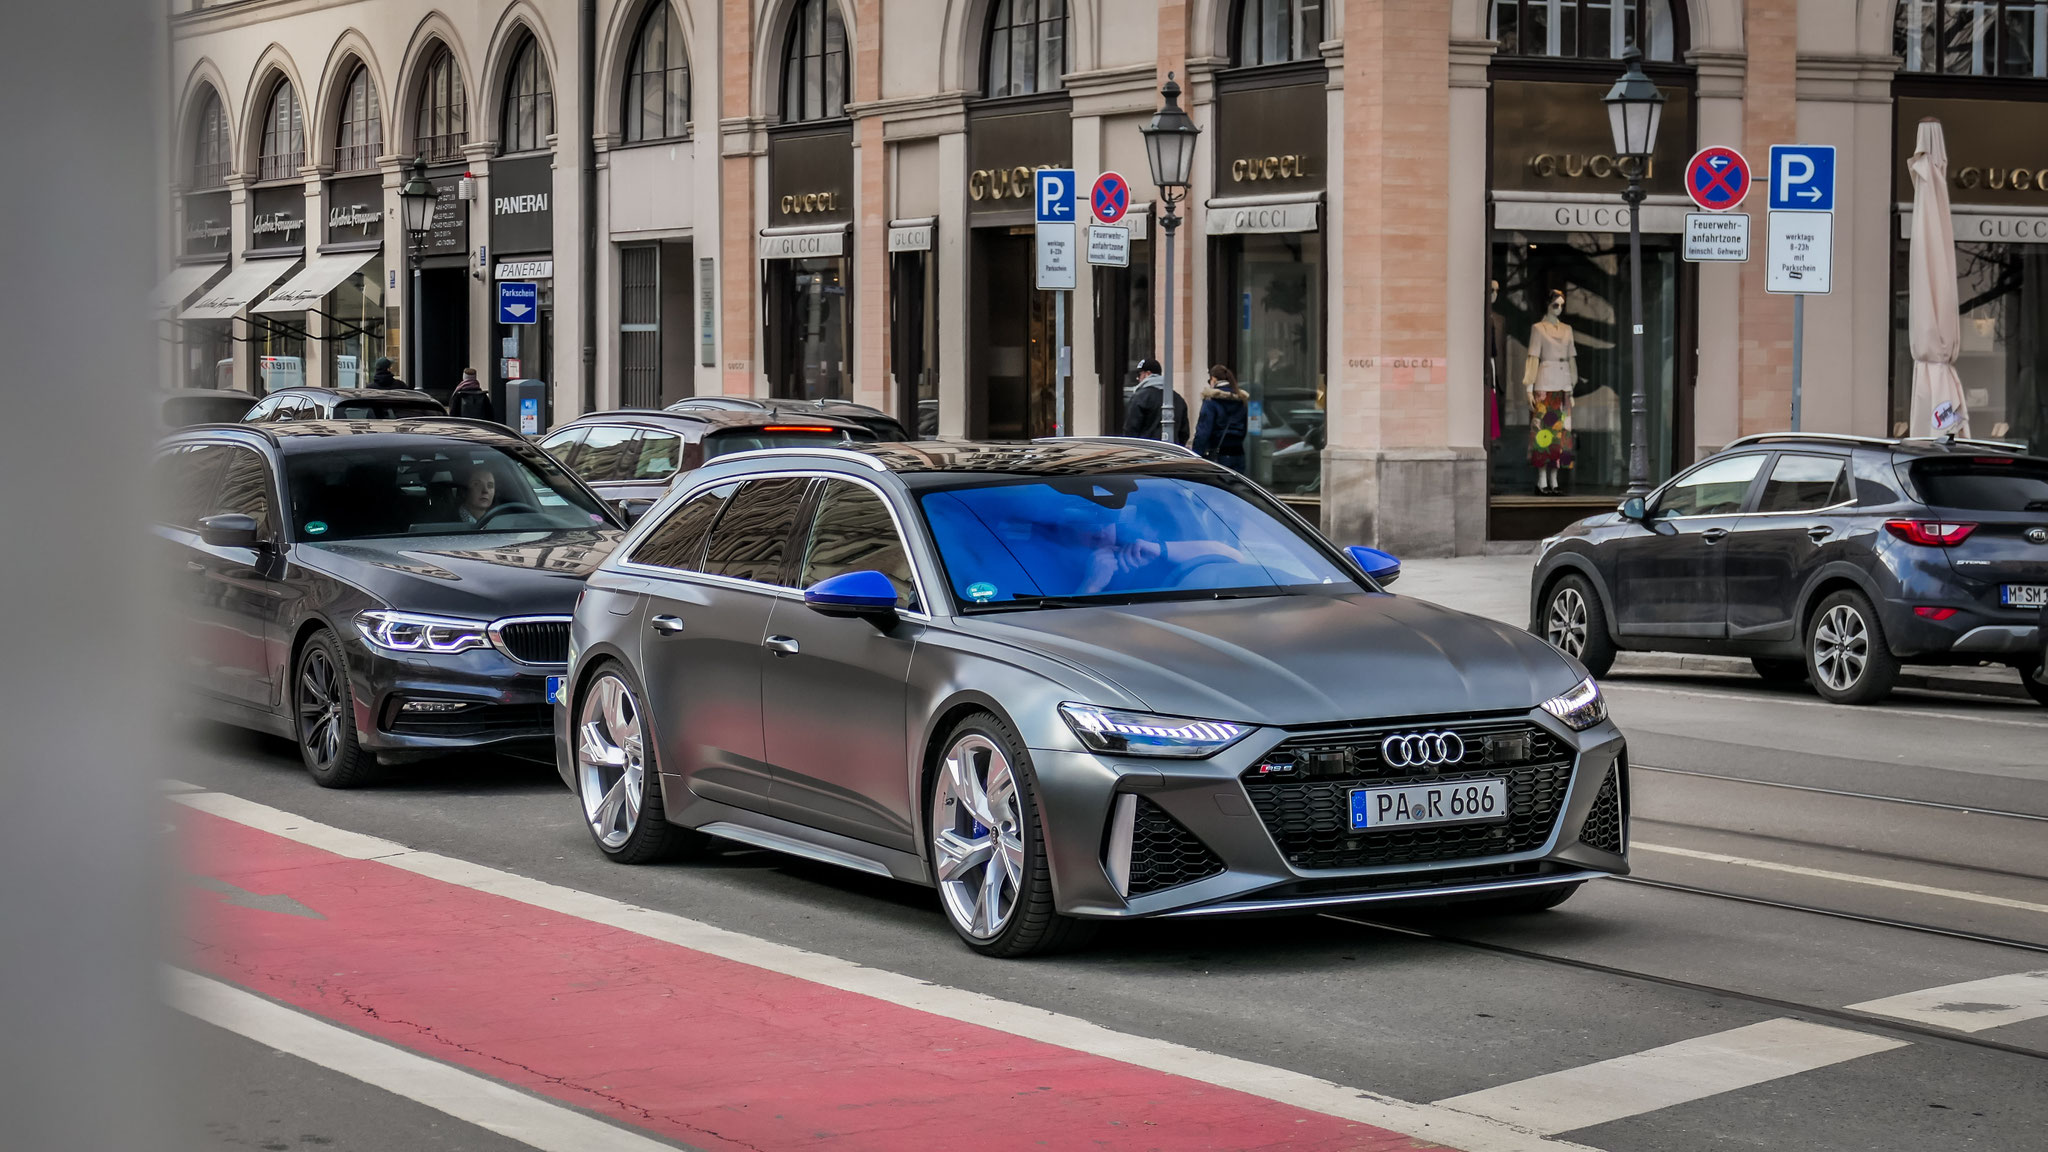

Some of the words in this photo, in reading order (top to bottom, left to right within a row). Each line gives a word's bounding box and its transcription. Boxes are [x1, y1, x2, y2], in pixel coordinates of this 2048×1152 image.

[1232, 154, 1304, 182] GUCCI
[1534, 153, 1653, 179] GUCCI
[970, 164, 1060, 201] GUC
[1780, 154, 1815, 202] P
[1960, 166, 2048, 191] GUCC
[494, 193, 548, 215] PANERAI
[781, 192, 837, 215] GUCCI
[1042, 177, 1064, 216] P
[1235, 210, 1287, 228] GUCCI
[1555, 207, 1631, 226] GUCC
[1693, 220, 1742, 230] Feuerwehr-
[1980, 219, 2047, 238] GUCC
[895, 231, 925, 246] GUCCI
[1093, 230, 1124, 240] Feuerwehr-
[1692, 234, 1741, 244] anfahrtzone
[1785, 233, 1815, 242] werktags
[782, 238, 820, 254] GUCCI
[1717, 247, 1744, 257] Gehweg)
[1790, 243, 1810, 251] 8-23h
[500, 262, 548, 278] PANERAI
[1782, 263, 1816, 272] Parkschein
[502, 288, 535, 297] Parkschein
[1394, 359, 1434, 369] GUCCI
[2032, 531, 2046, 539] KIA
[2009, 587, 2017, 602] M
[2025, 587, 2041, 603] SM
[1376, 793, 1411, 822] PA
[1427, 790, 1444, 818] R
[1451, 786, 1495, 816] 686
[1356, 813, 1363, 822] D
